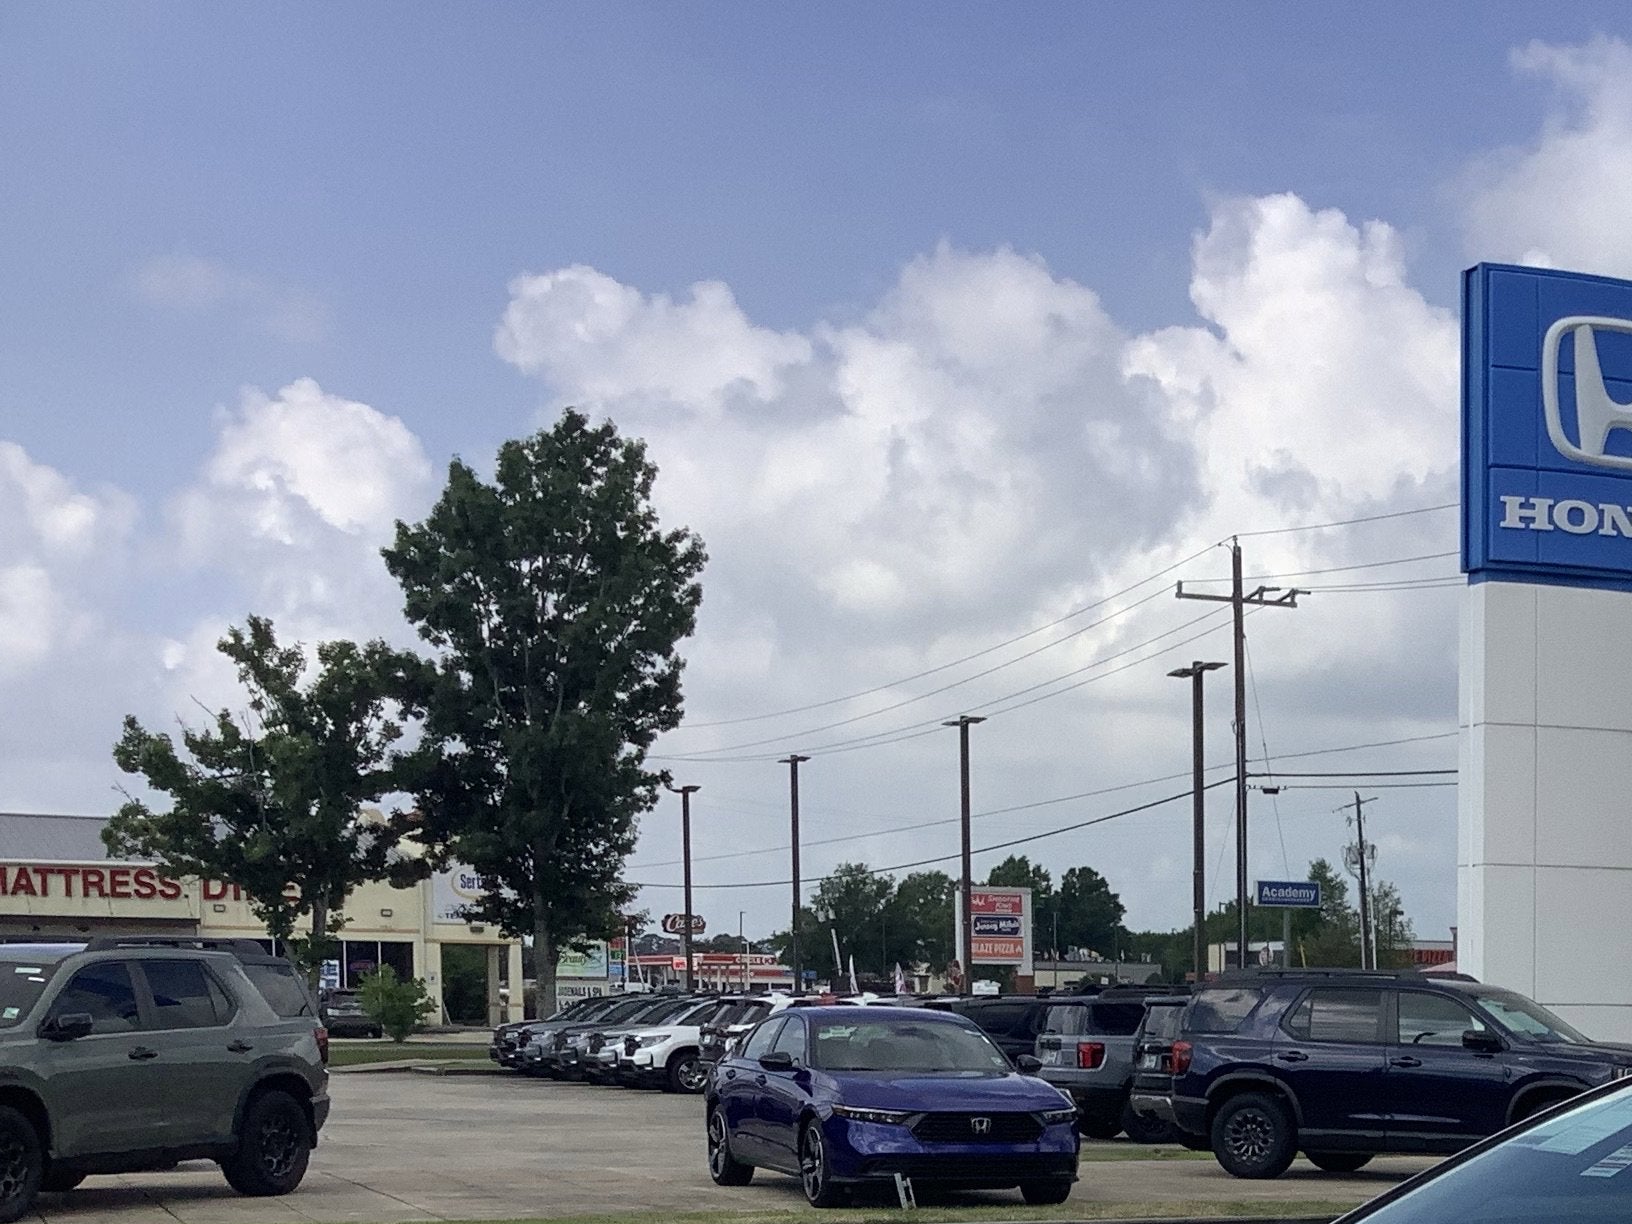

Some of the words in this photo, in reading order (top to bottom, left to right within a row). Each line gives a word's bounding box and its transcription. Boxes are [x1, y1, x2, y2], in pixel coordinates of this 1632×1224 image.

[0, 867, 183, 899] ATTRESS
[1262, 886, 1316, 902] Academy
[667, 912, 704, 932] Cae's
